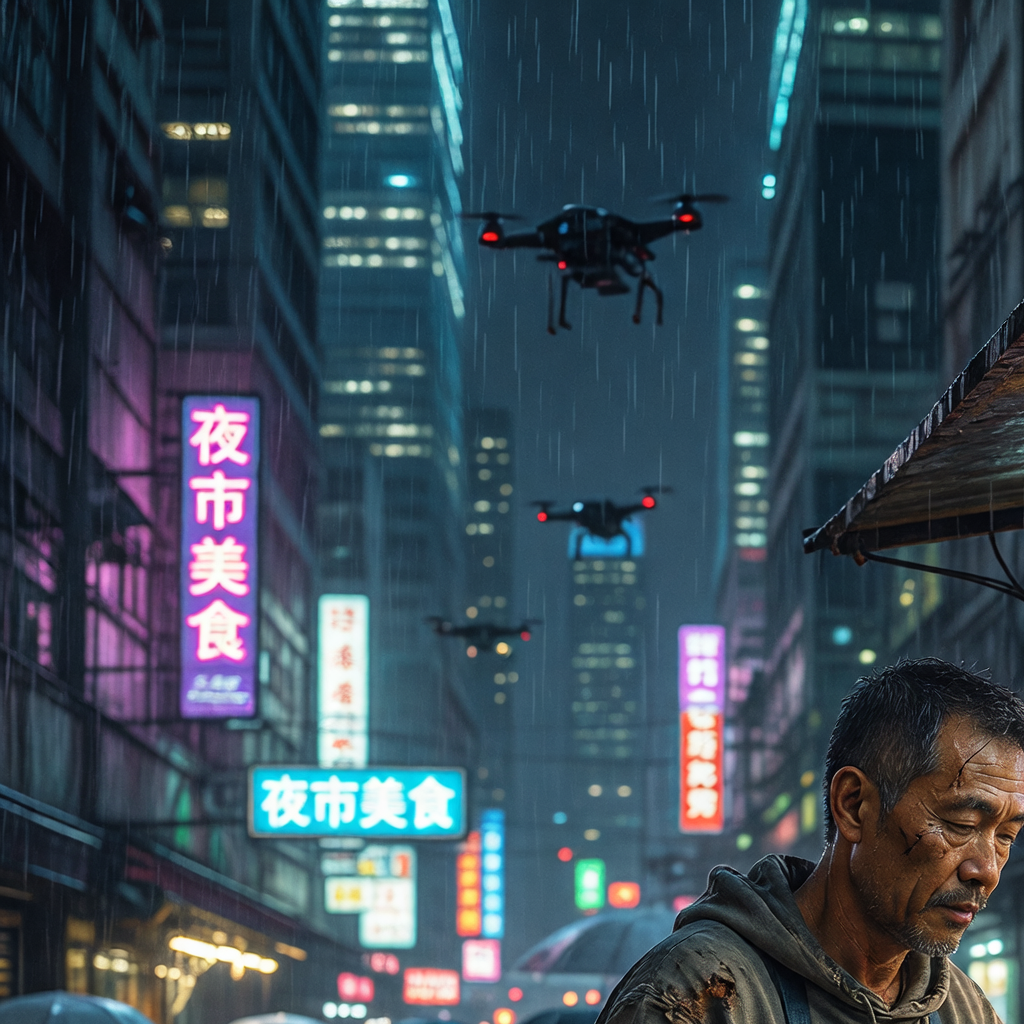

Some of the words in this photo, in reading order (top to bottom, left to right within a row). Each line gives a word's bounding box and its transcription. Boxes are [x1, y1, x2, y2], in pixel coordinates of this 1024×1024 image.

[187, 404, 250, 662] 夜市美食
[261, 775, 456, 830] 夜市美食
